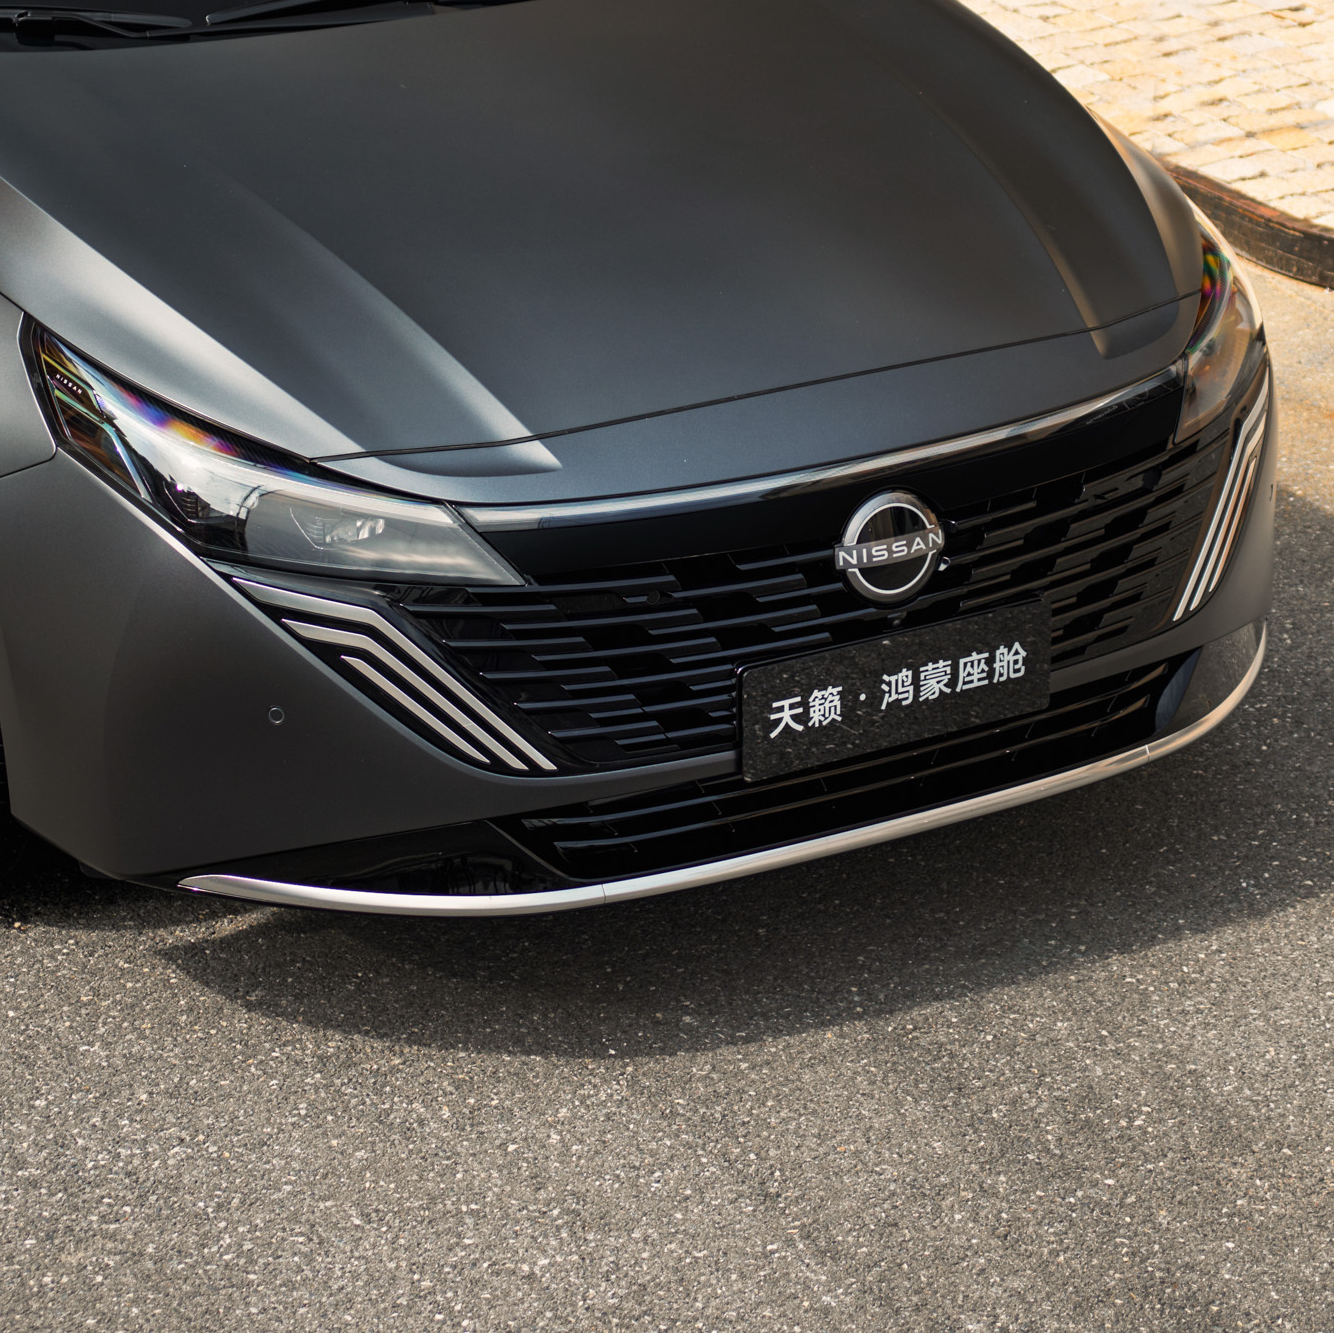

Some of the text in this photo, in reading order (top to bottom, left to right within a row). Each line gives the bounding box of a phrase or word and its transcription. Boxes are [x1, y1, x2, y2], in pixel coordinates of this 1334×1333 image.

[55, 373, 83, 395] NISSAN
[838, 529, 943, 567] NISSAN
[769, 641, 1028, 740] 天籁·鸿蒙座舱
